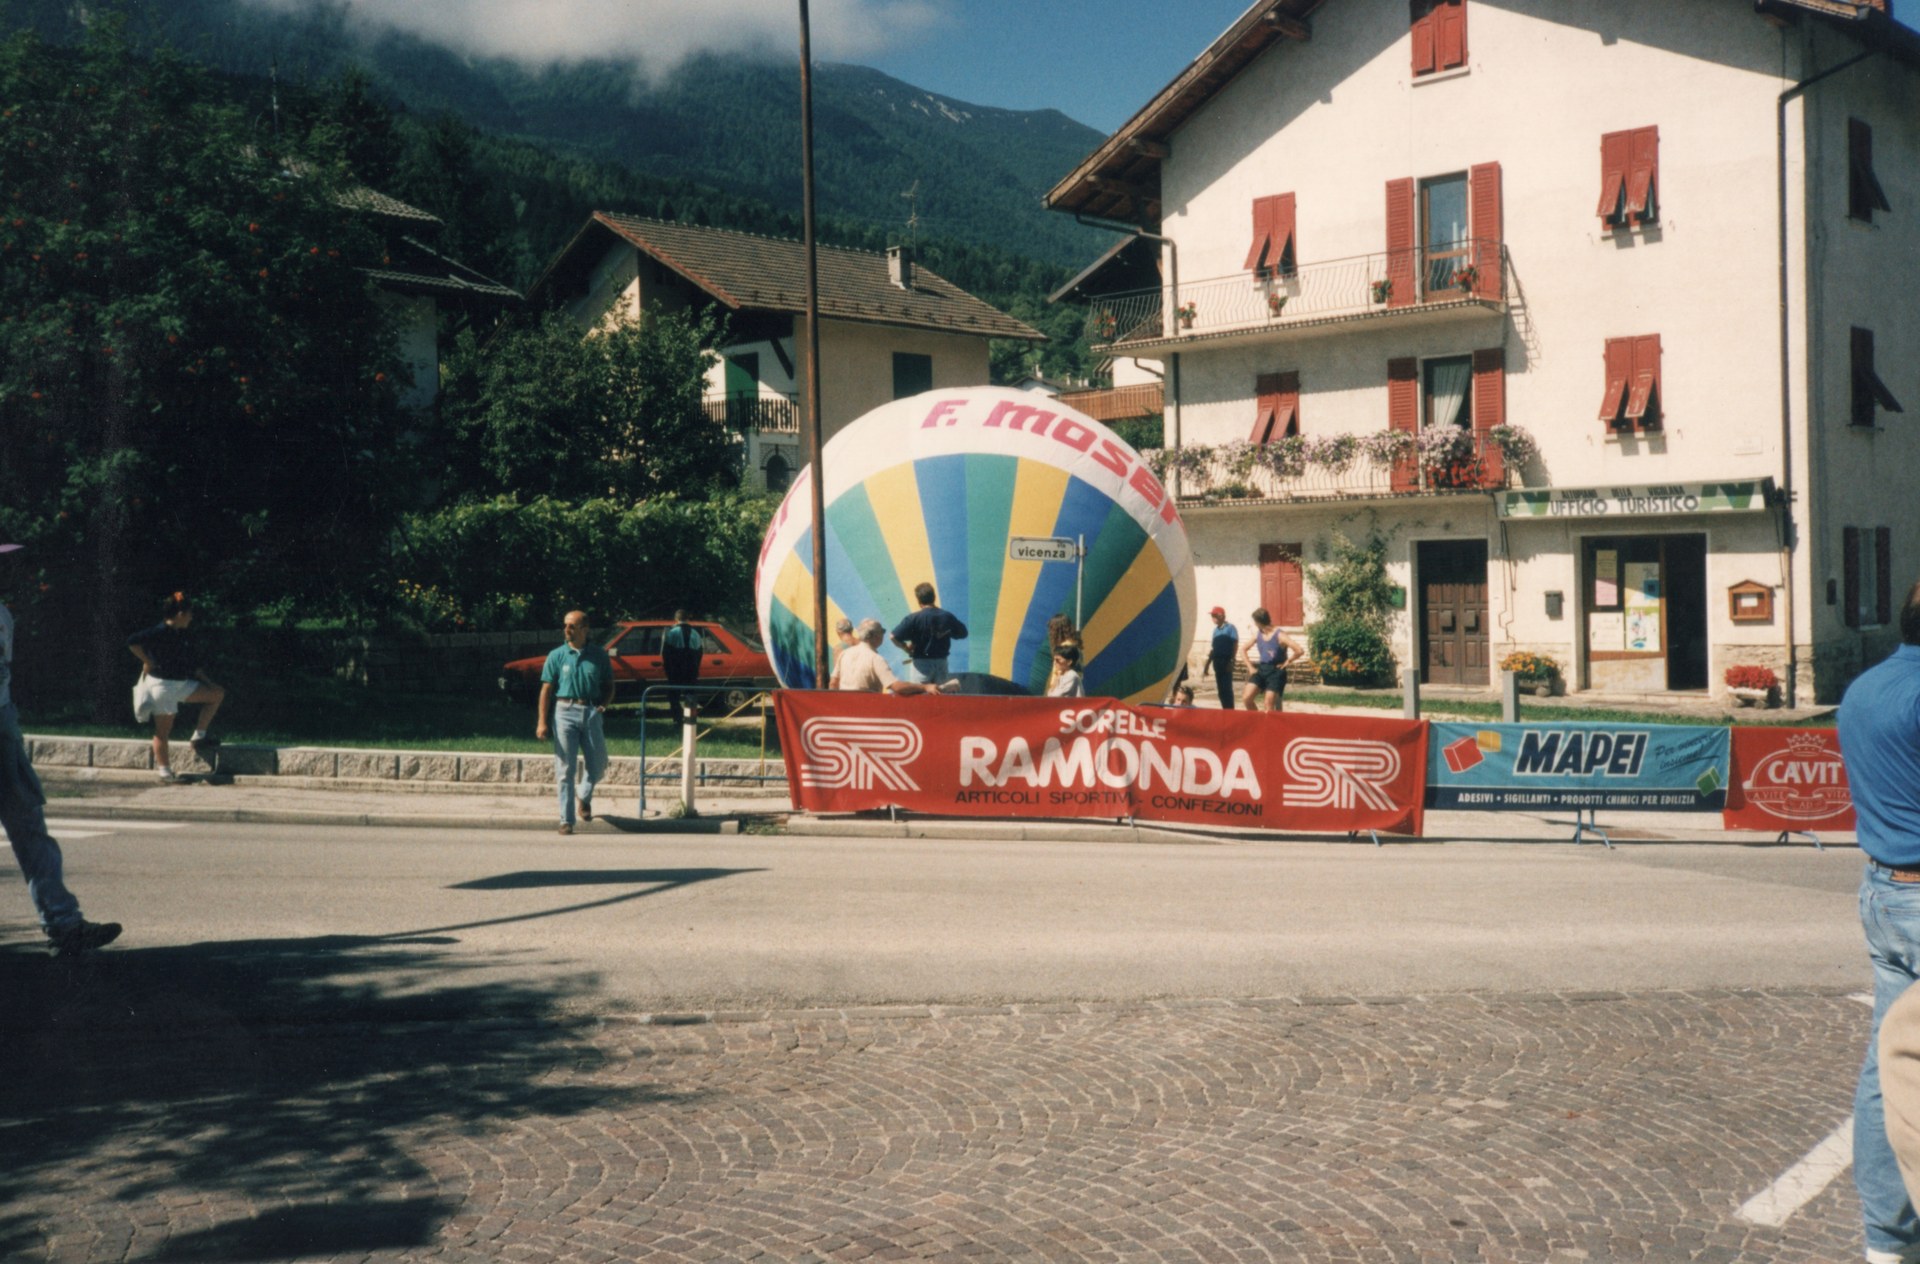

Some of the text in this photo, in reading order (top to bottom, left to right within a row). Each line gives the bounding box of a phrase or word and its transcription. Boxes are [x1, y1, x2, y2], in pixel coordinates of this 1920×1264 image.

[1611, 487, 1633, 498] DELLA
[1550, 495, 1699, 516] UFFICIO TURISTICO
[1018, 546, 1066, 558] vicenza
[1058, 708, 1168, 741] SORELLE
[1512, 729, 1650, 777] MAPEI
[959, 735, 1262, 800] RAMONDA
[955, 791, 1040, 804] ARTICOLI
[1151, 795, 1264, 816] CONFEZIONI
[1457, 793, 1696, 805] ADESIVI SIGILLANTI PRODOTTI CHIMICI PER EDILIZIA
